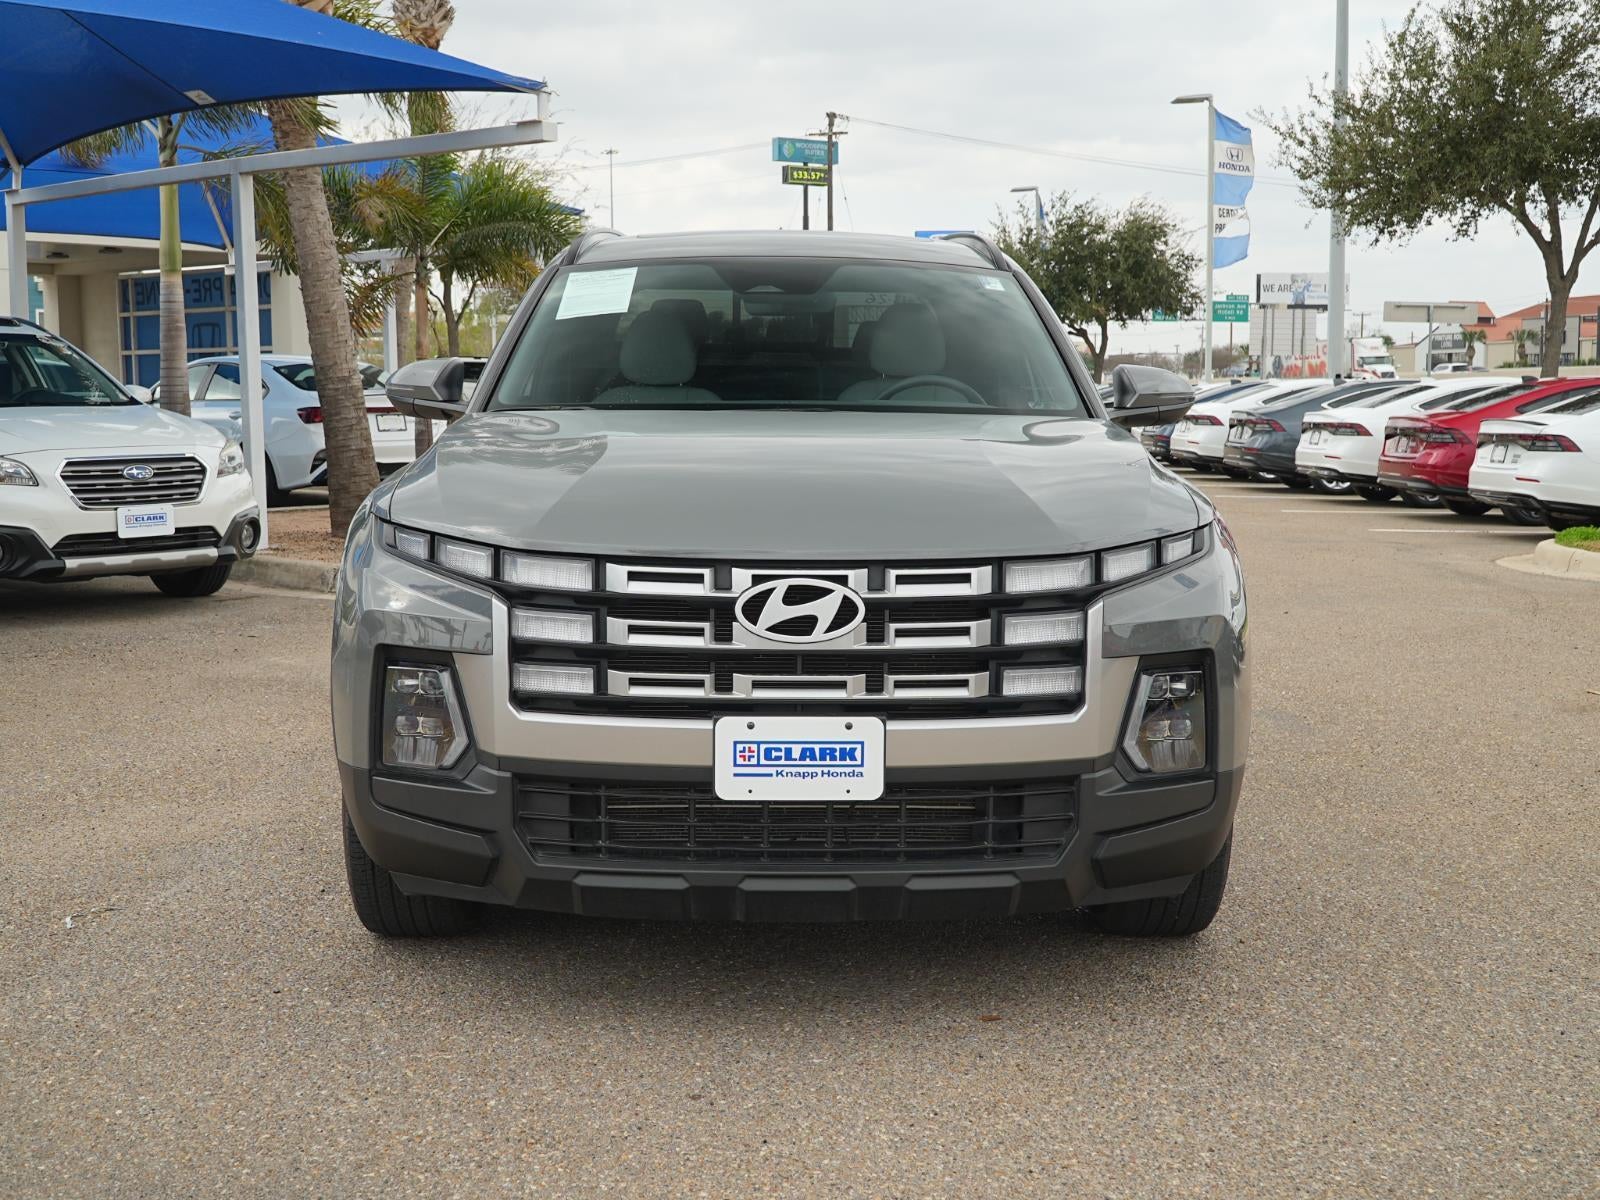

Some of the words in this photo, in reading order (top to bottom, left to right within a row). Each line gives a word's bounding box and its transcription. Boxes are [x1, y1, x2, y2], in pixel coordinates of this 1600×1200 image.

[1218, 161, 1251, 173] HONDA
[1262, 284, 1275, 293] WE
[1277, 284, 1294, 293] ARE
[763, 746, 858, 762] CLARK
[775, 769, 819, 780] Knapp
[821, 769, 864, 778] Honda
